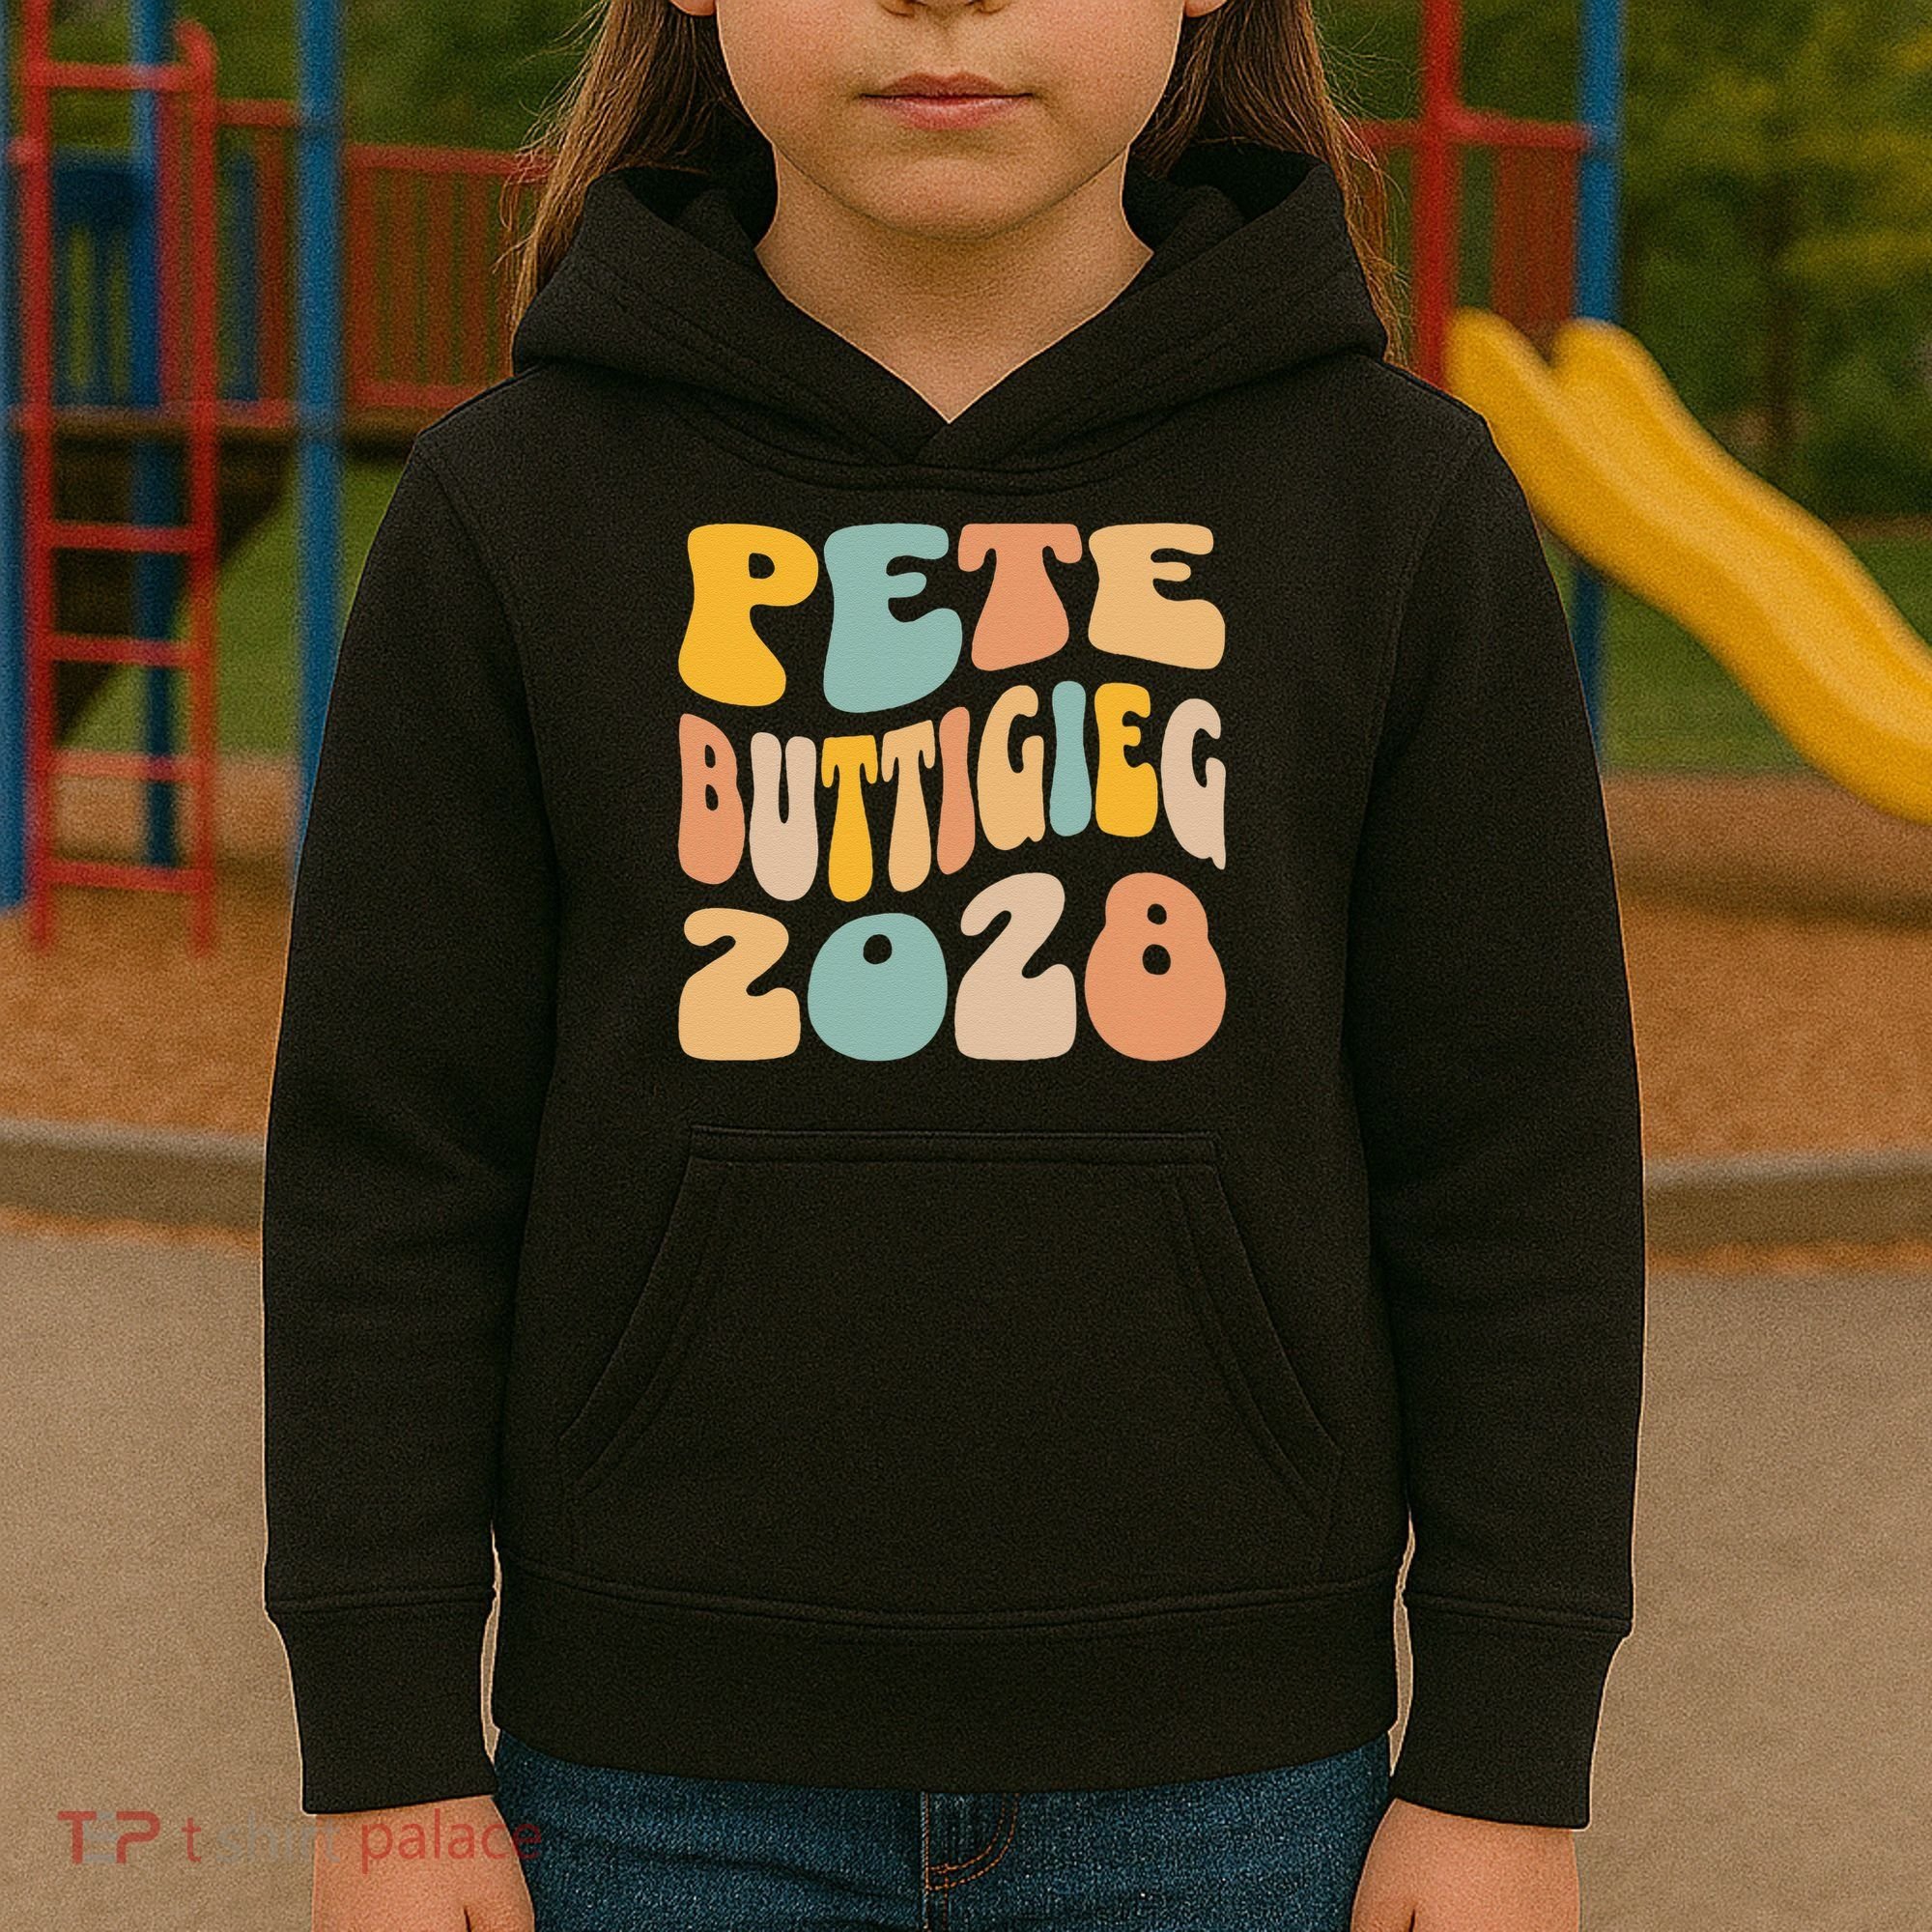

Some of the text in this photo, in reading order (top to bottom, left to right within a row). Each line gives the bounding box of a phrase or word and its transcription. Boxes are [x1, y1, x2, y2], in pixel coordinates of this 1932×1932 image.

[678, 523, 1225, 713] PETE
[678, 681, 1226, 902] BUTTIGIEG
[678, 872, 1226, 1061] 2028
